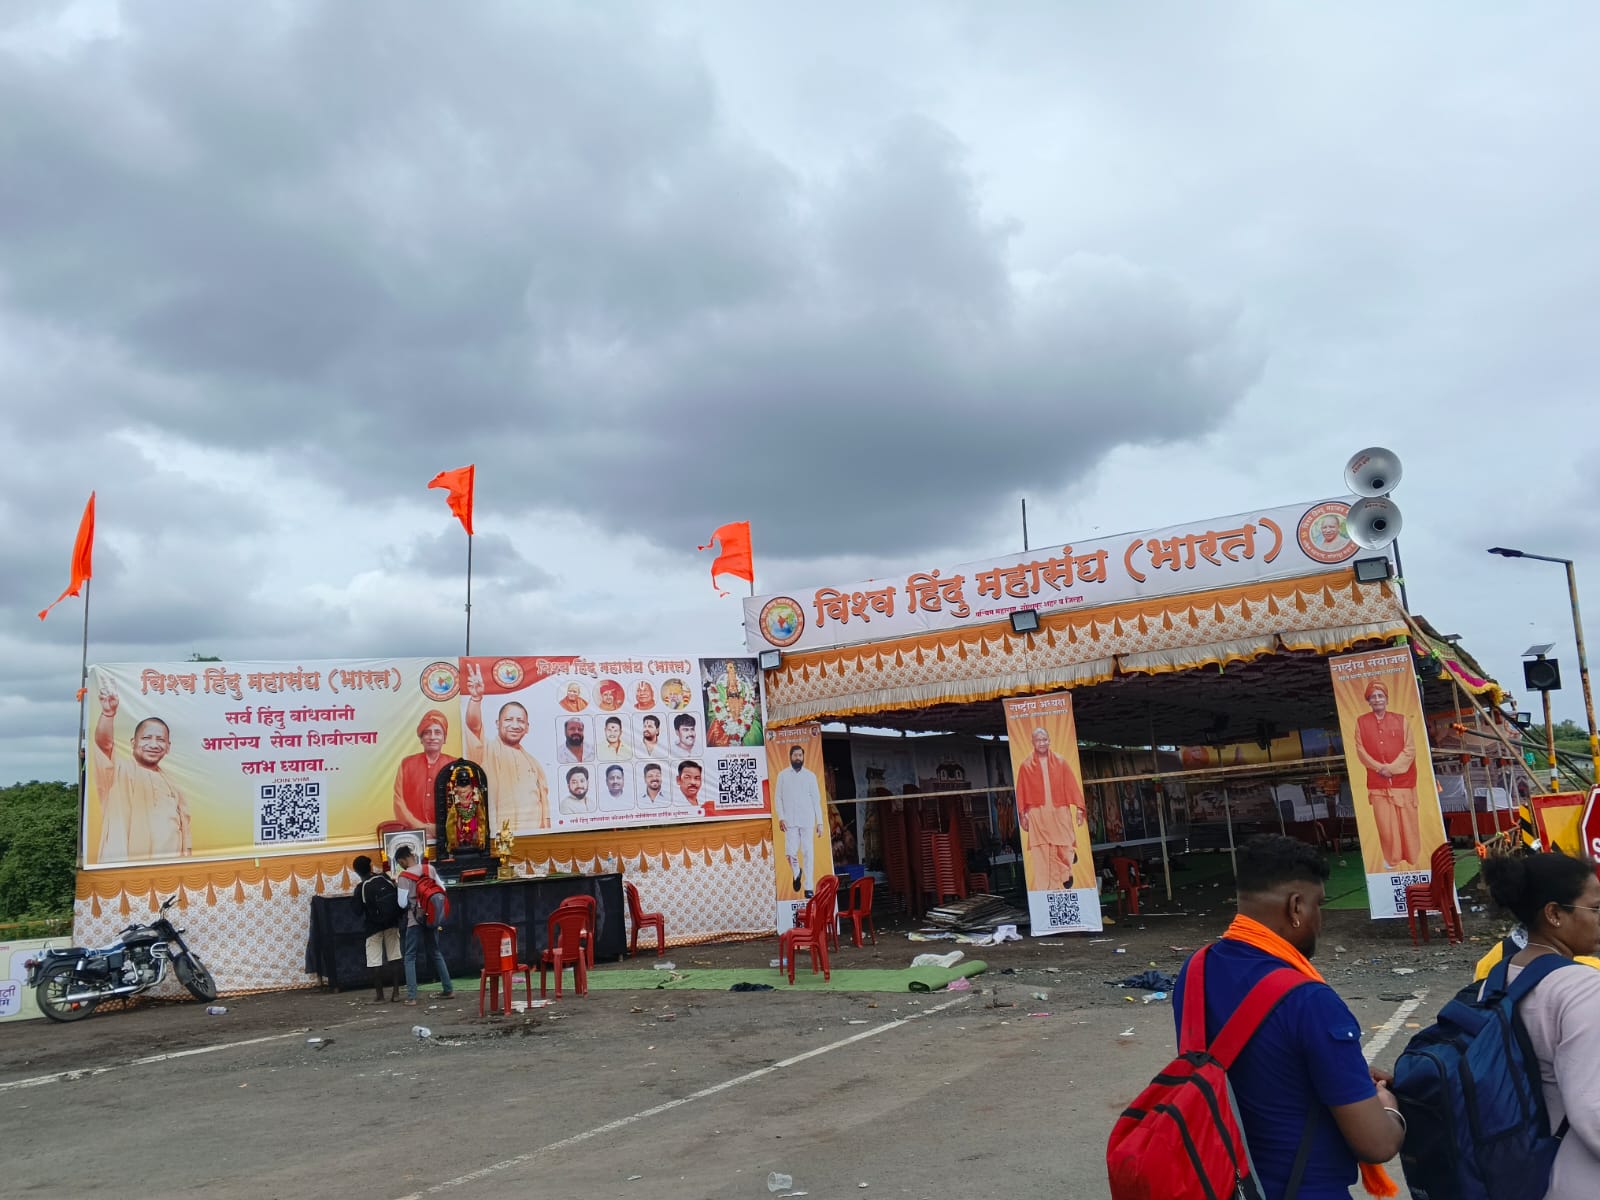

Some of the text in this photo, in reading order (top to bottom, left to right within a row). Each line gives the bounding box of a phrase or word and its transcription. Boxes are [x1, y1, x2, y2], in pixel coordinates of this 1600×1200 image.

[813, 586, 897, 628] विश्व
[905, 569, 971, 618] हिंदु
[975, 545, 1109, 600] महासंघ
[1124, 517, 1284, 583] (भारत)
[536, 658, 570, 676] विश्व
[600, 658, 643, 675] महासंघ
[648, 659, 692, 675] (भारत)
[1367, 653, 1408, 668] संयोजक
[141, 669, 198, 695] विश्व
[203, 667, 243, 700] हिंदु
[247, 665, 321, 695] महासंघ
[327, 667, 402, 694] (भारत)
[225, 704, 355, 729] सर्व हिंदु बांधवांनी
[201, 729, 378, 751] आरोग्य सेवा शिबीराचा
[241, 760, 276, 775] लाभ
